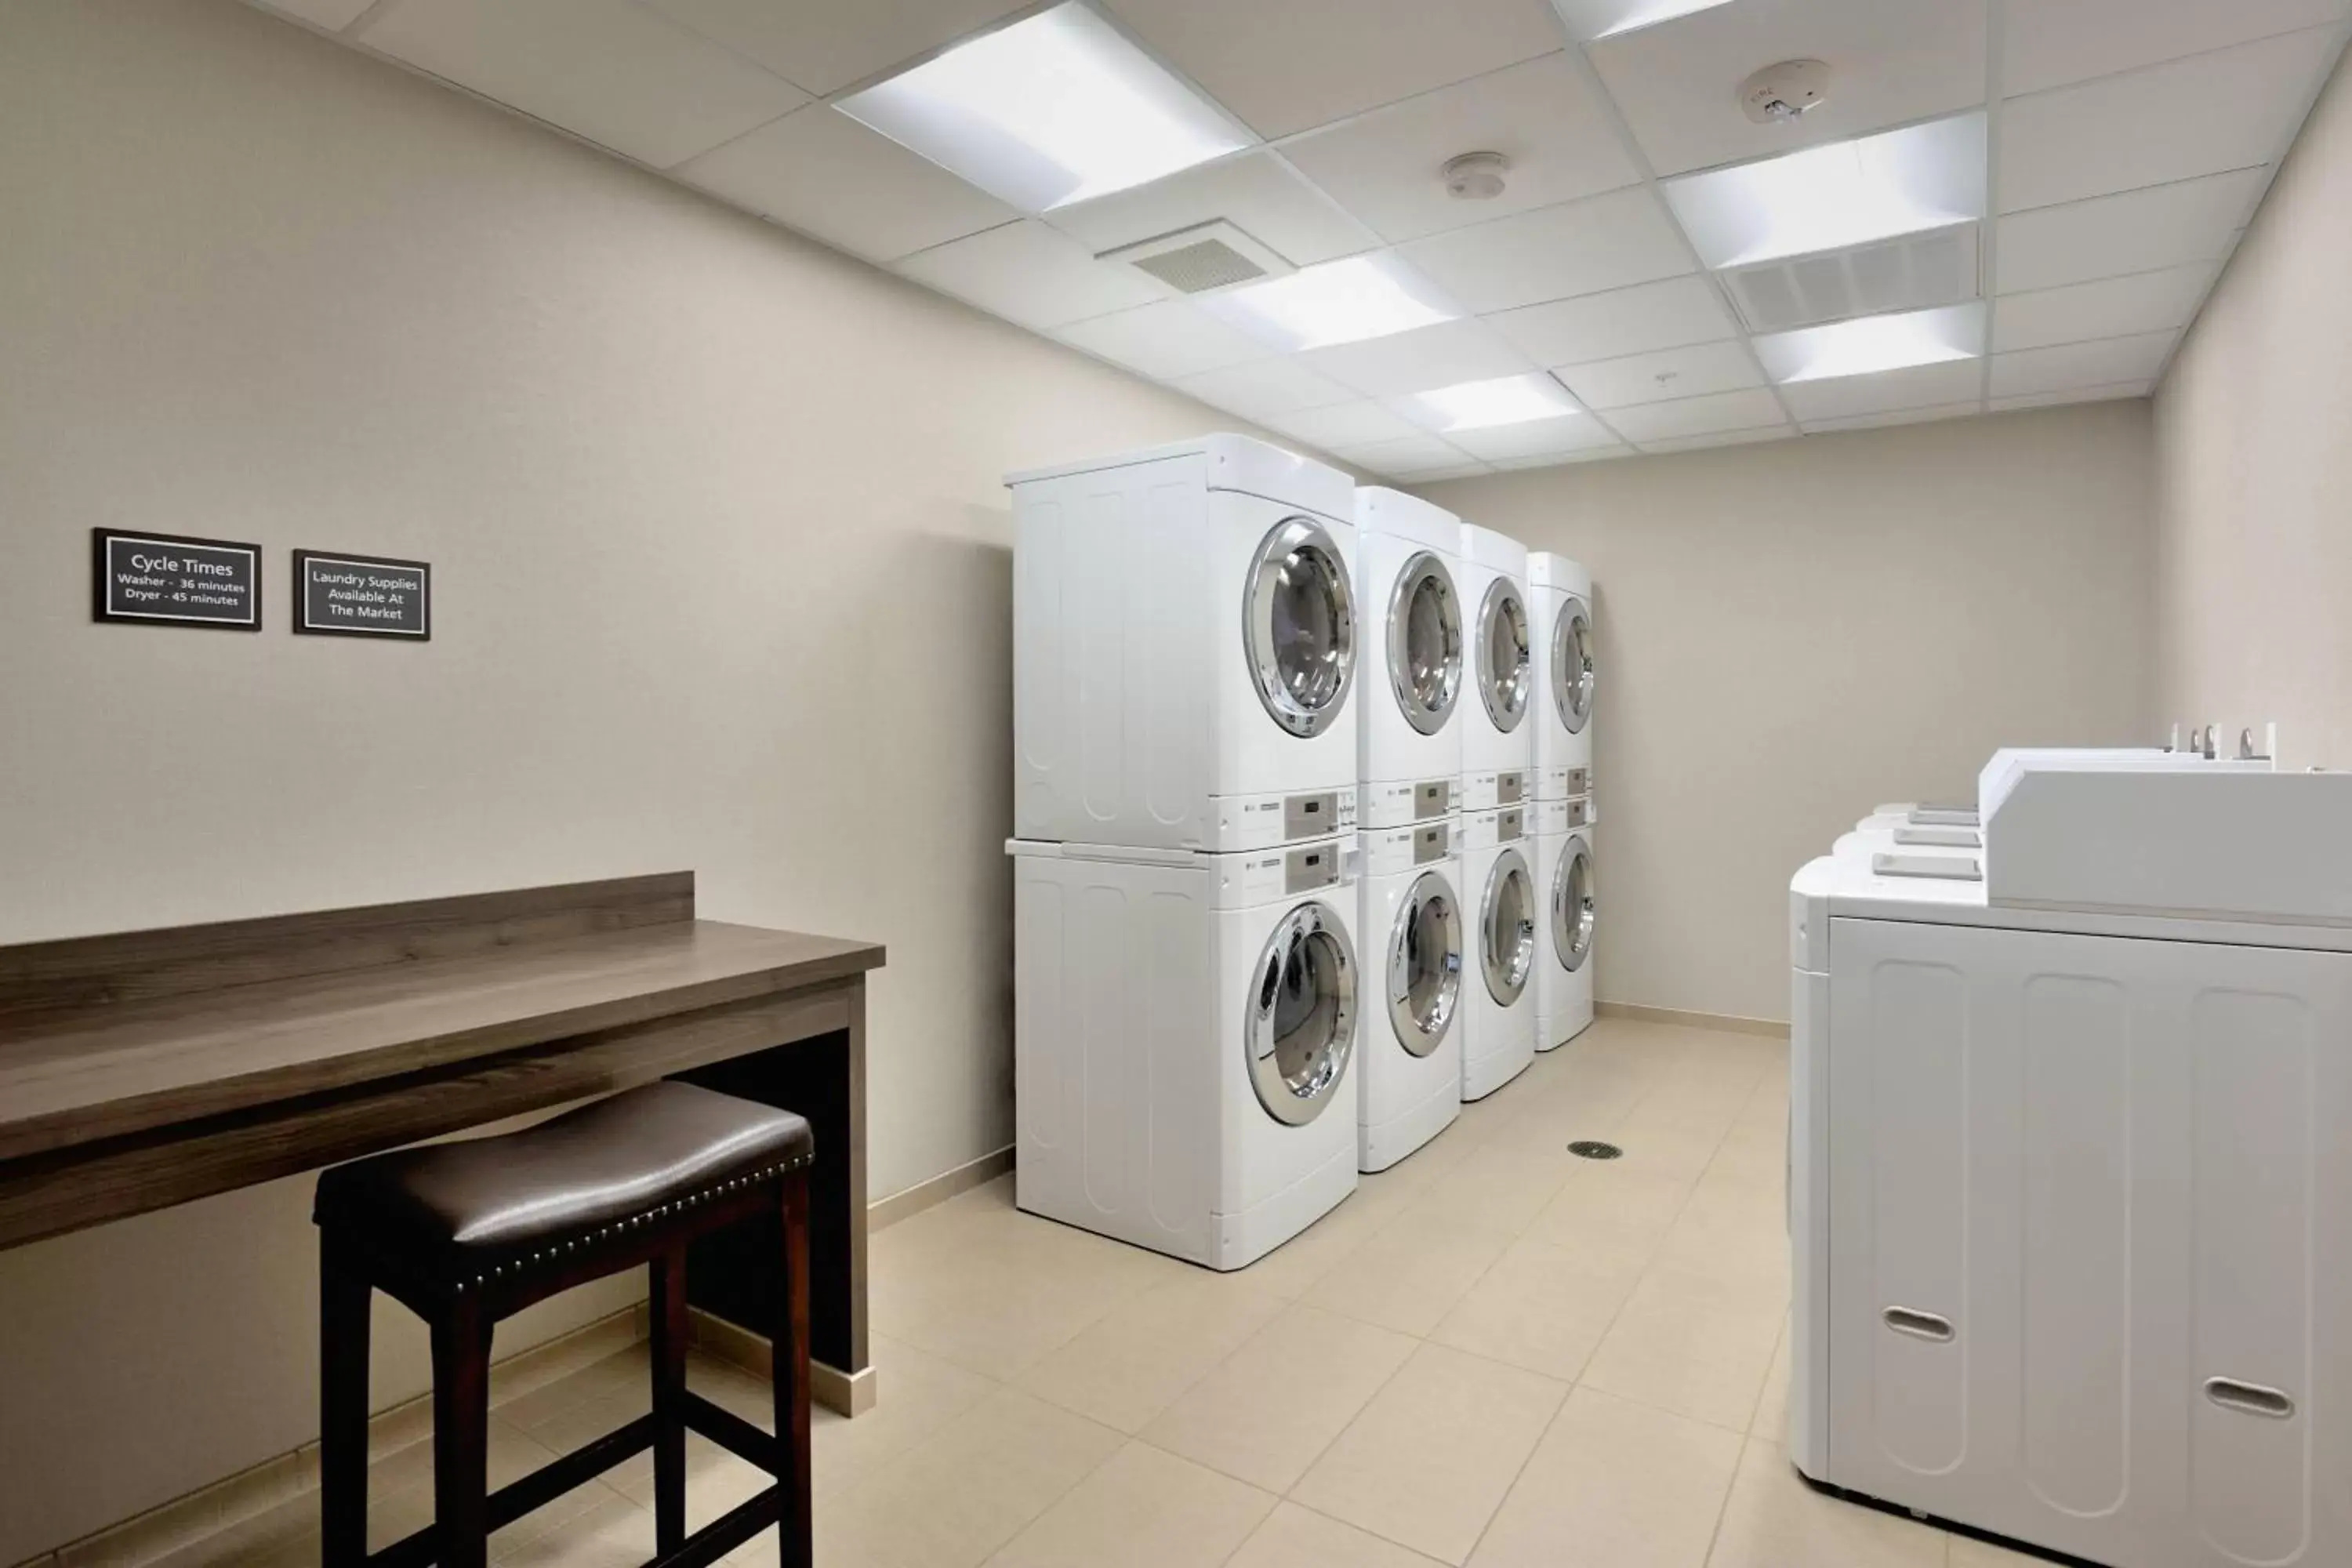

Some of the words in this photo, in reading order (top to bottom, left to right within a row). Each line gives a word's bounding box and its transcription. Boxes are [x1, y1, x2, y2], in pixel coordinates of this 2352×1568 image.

[131, 554, 179, 573] Cycle
[182, 558, 234, 577] Times
[117, 573, 165, 587] Washer
[180, 579, 195, 590] 36
[198, 579, 245, 593] minutes
[313, 570, 366, 588] Laundry
[367, 575, 418, 590] Supplies
[125, 588, 162, 601] Dryer
[172, 592, 187, 602] 45
[191, 593, 238, 606] minutes
[328, 588, 386, 603] Available
[388, 593, 405, 604] At
[329, 604, 354, 617] The
[357, 606, 403, 620] Market
